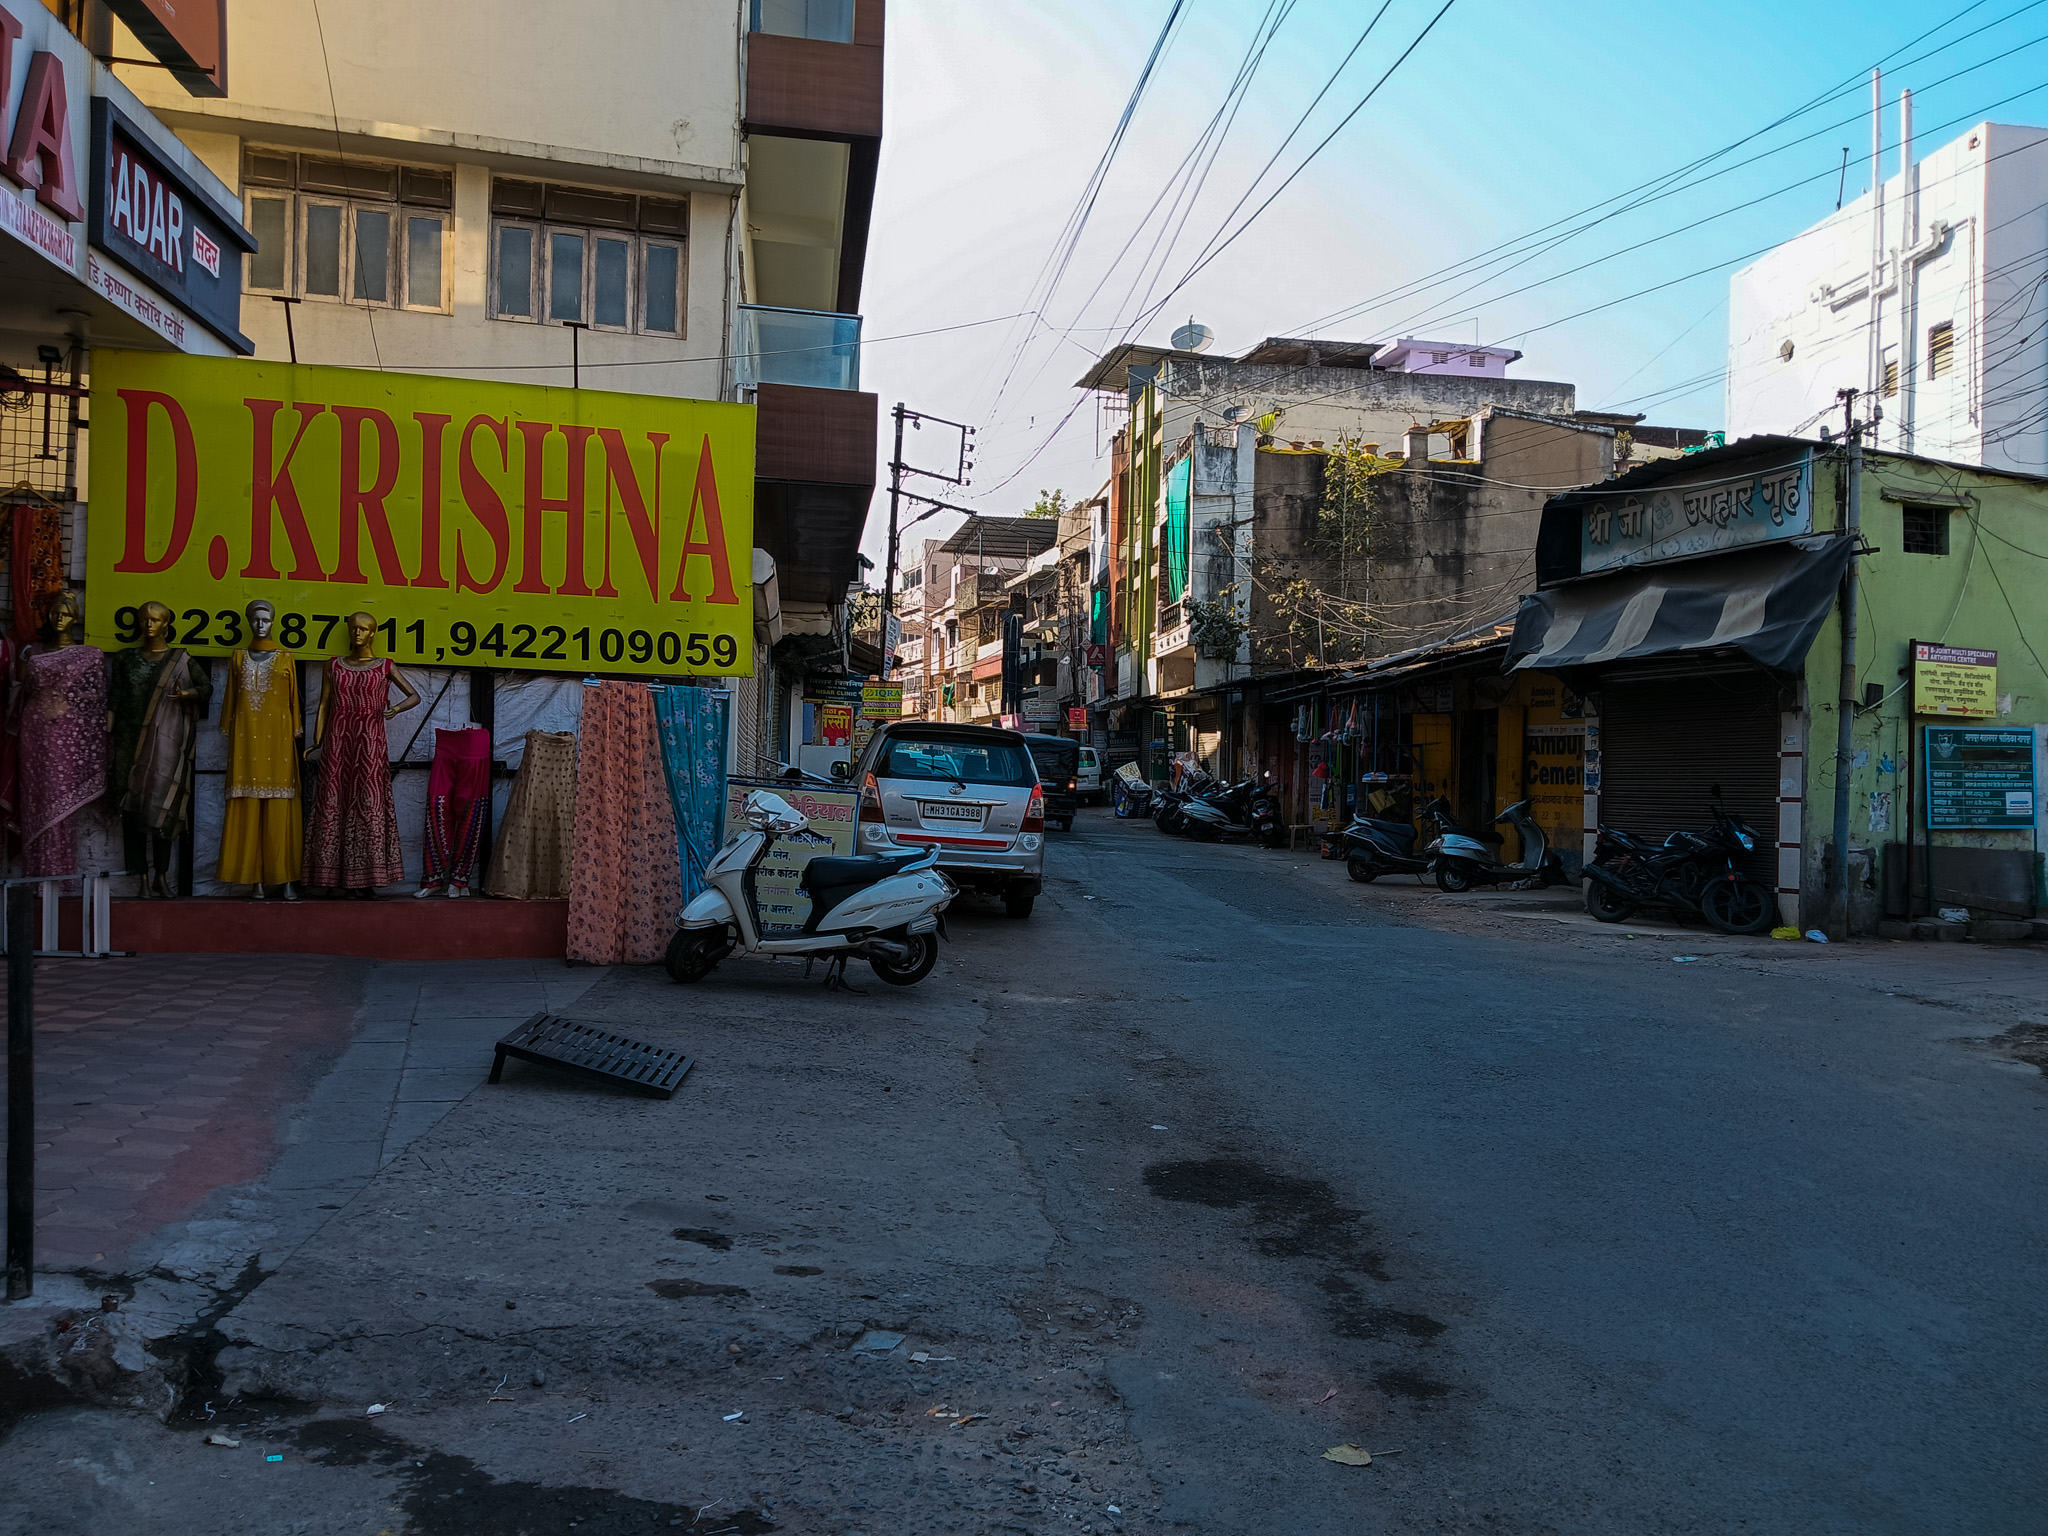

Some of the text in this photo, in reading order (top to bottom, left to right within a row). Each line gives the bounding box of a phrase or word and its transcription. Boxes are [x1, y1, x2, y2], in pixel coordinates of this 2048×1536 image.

[110, 152, 184, 273] ADAR
[195, 231, 218, 273] सदर
[1588, 502, 1612, 546] श्री
[1617, 494, 1644, 539] जी
[1683, 478, 1755, 529] उपहार
[1761, 468, 1802, 527] गृह
[1930, 654, 1977, 664] ARTHRITIS CENTRE
[1967, 651, 1996, 659] SPECIALITY
[875, 689, 901, 698] IQRA
[1531, 685, 1556, 697] Ambuja
[1531, 698, 1555, 707] Cement
[1527, 736, 1585, 760] Ambuj
[1527, 760, 1585, 786] Cemen
[929, 806, 981, 818] MH31GA3988
[777, 867, 800, 878] कॉटन
